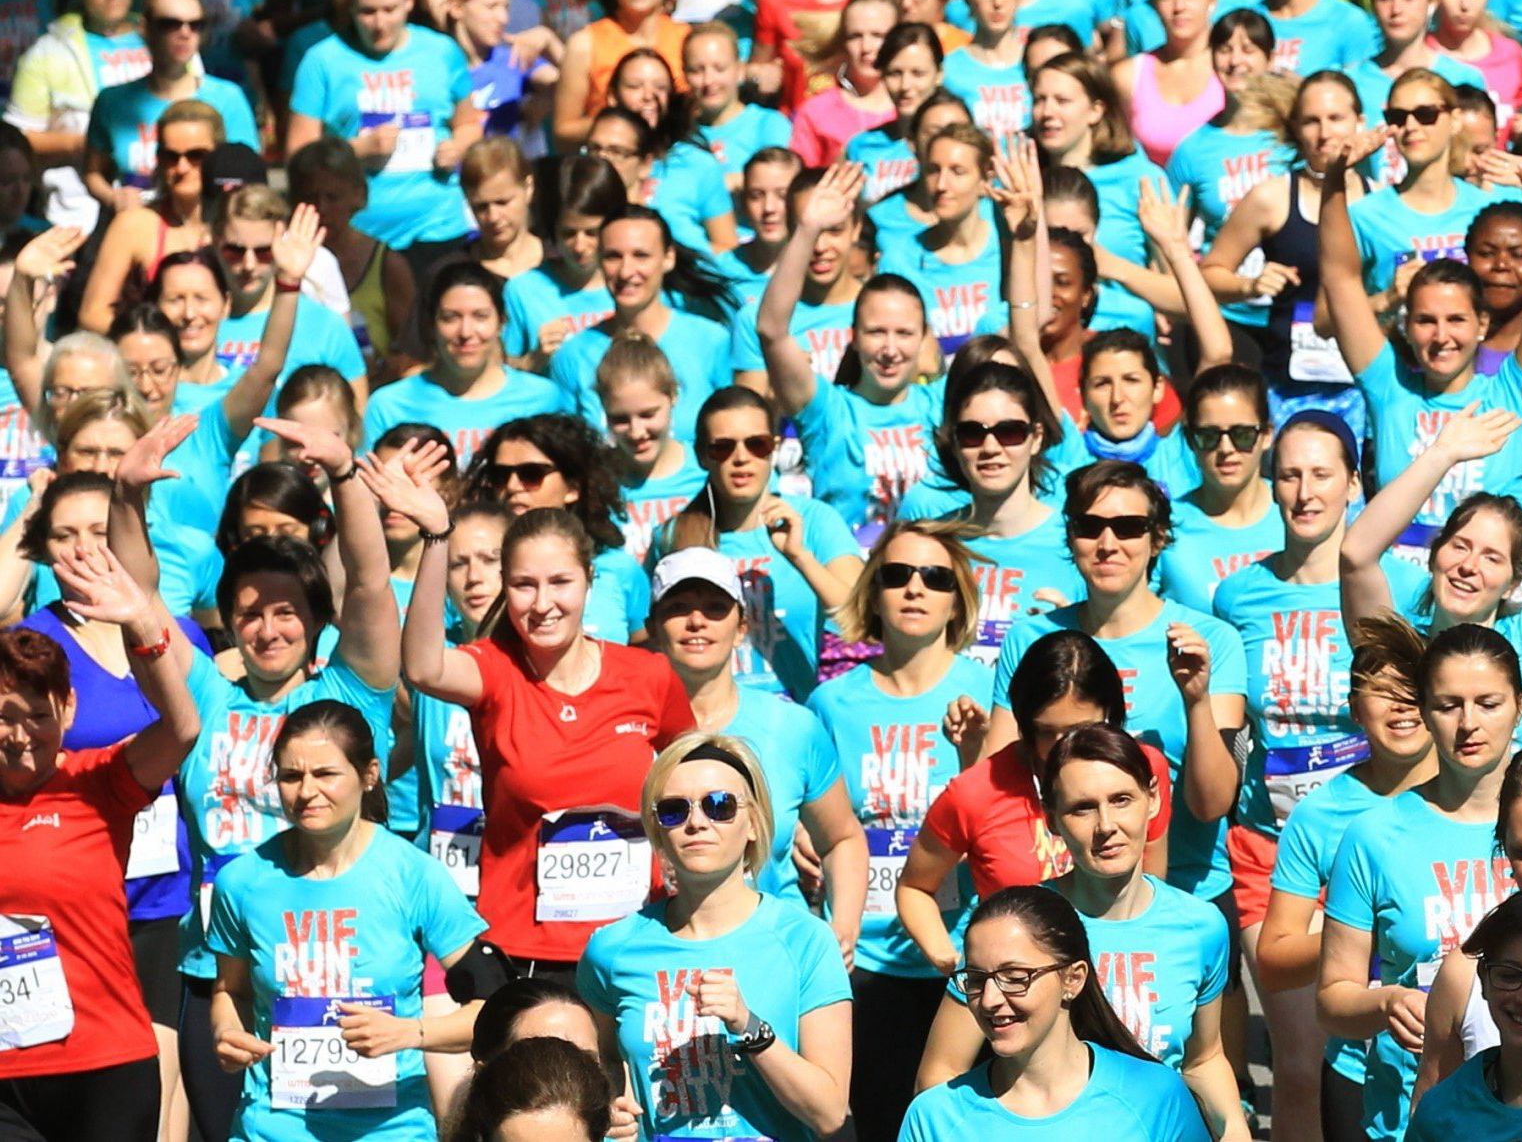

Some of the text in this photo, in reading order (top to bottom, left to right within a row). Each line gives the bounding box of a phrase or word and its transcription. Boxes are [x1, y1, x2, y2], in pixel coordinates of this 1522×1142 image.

[935, 284, 990, 311] VIE
[1272, 610, 1340, 653] VIE
[1262, 637, 1330, 676] RUN
[870, 724, 940, 766] VIE
[860, 753, 931, 791] RUN
[543, 851, 623, 880] 29827
[281, 908, 359, 957] VIE
[274, 940, 351, 984] RUN
